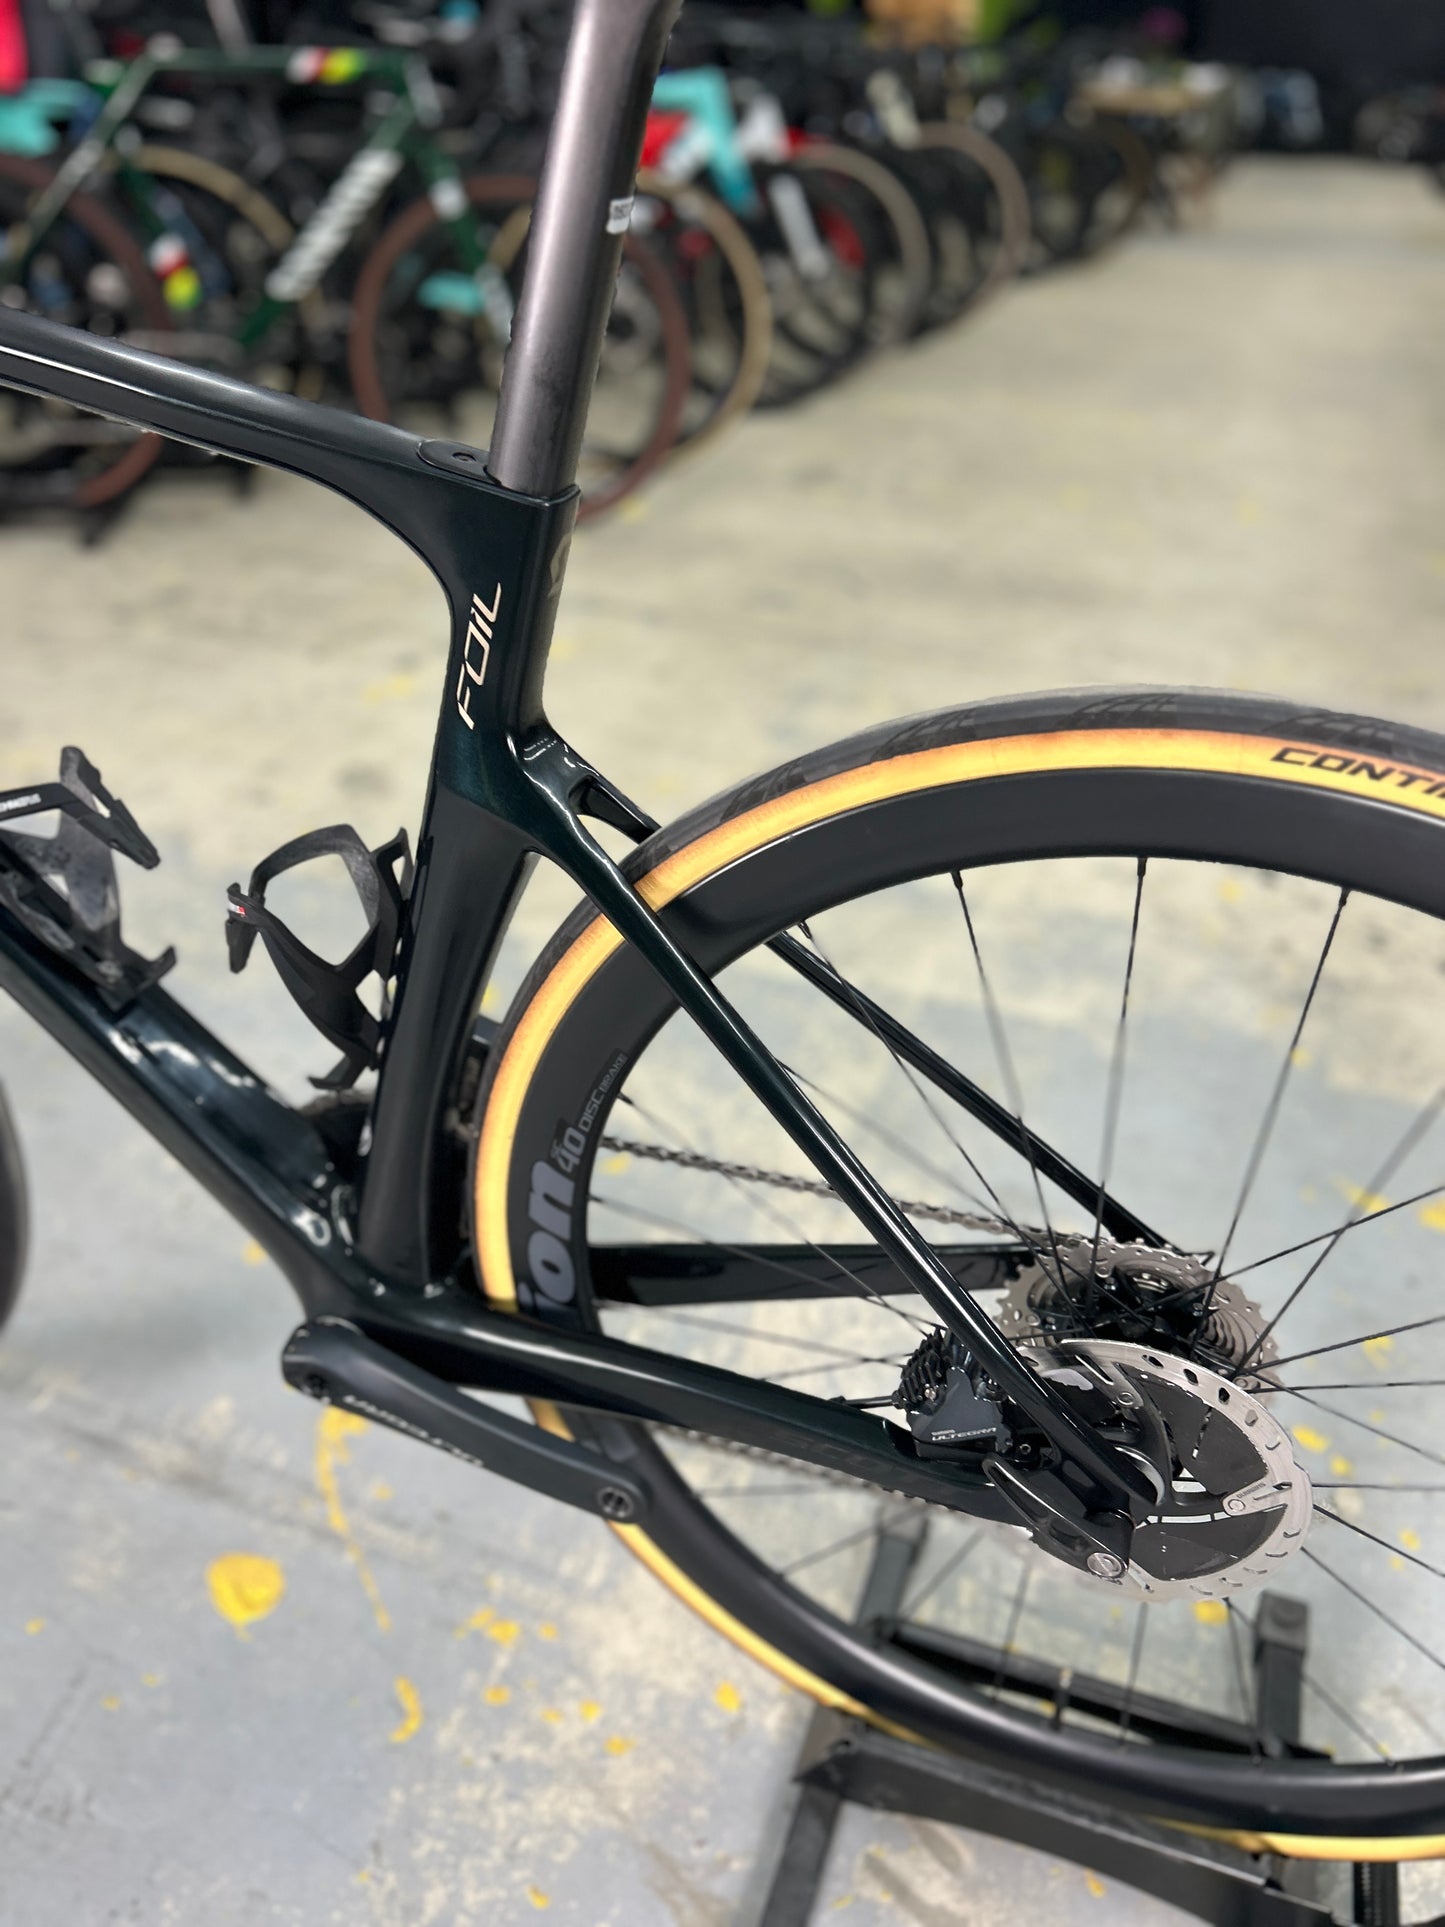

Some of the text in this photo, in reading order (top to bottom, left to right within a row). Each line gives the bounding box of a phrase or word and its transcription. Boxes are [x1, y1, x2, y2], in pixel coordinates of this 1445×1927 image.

[456, 582, 502, 730] FOIL
[557, 1126, 587, 1174] 40
[578, 1088, 605, 1133] DISC
[598, 1052, 629, 1094] BRAKE
[931, 1427, 997, 1441] ULTEGRA
